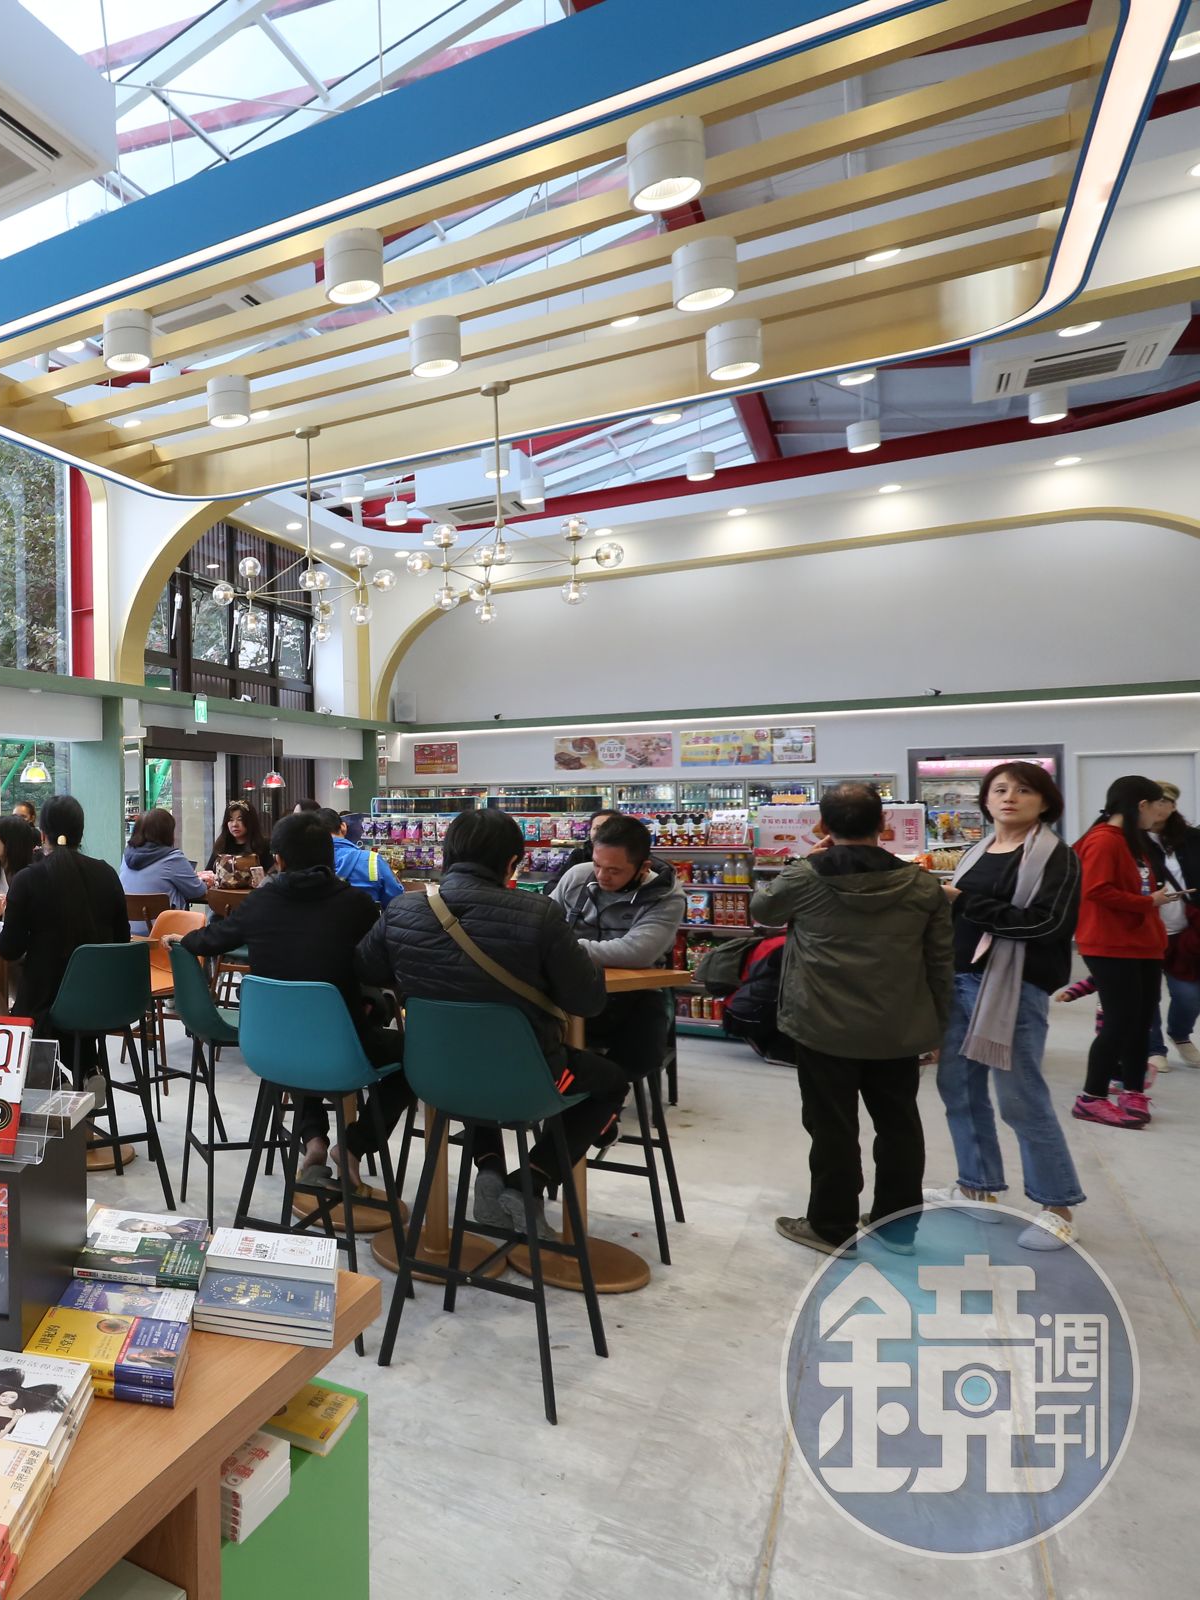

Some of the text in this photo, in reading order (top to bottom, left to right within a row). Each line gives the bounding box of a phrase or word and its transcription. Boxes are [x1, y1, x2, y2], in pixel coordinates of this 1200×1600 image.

[10, 1449, 42, 1492] 解憂電影院
